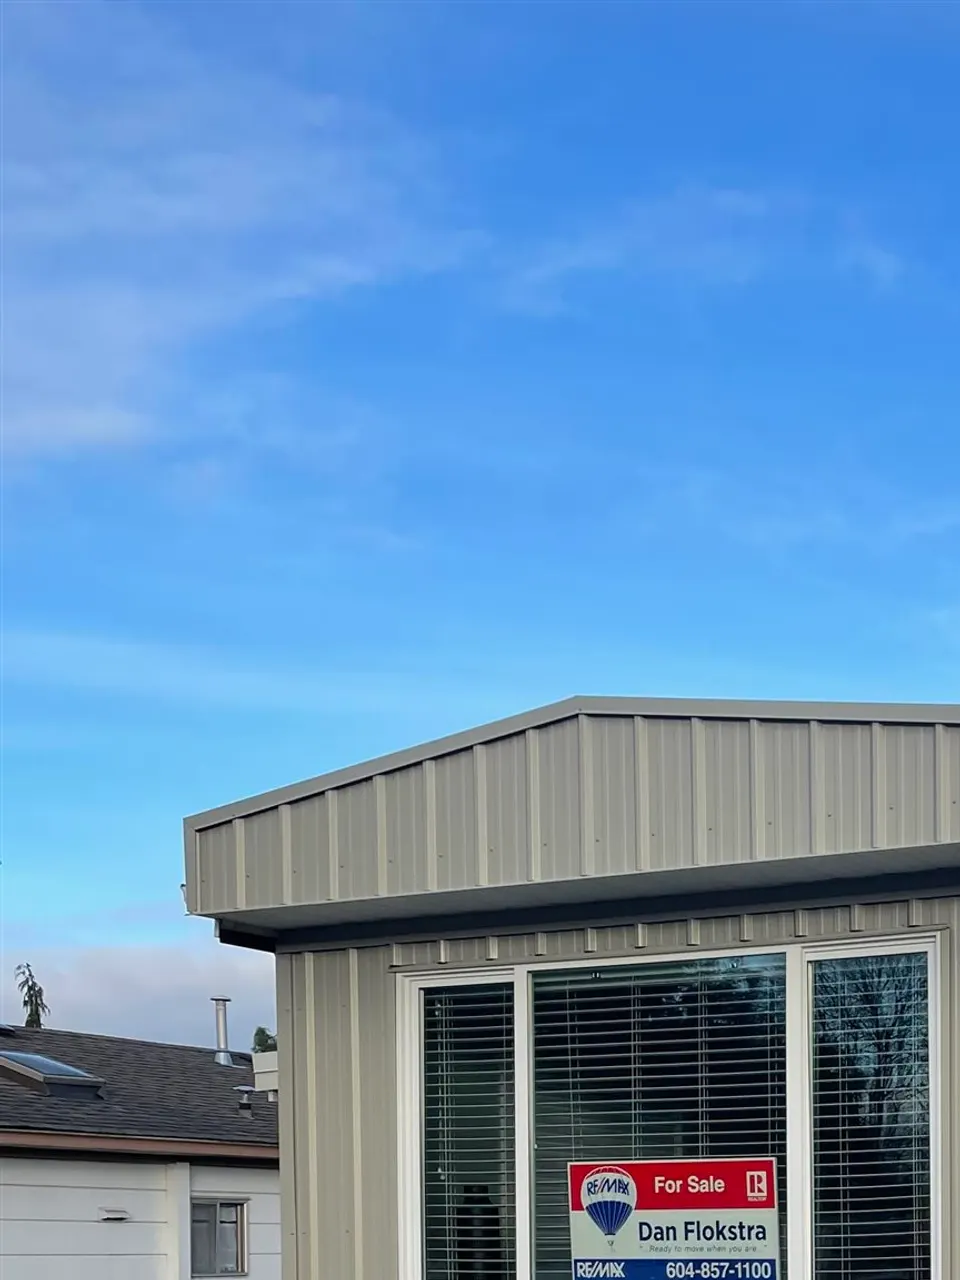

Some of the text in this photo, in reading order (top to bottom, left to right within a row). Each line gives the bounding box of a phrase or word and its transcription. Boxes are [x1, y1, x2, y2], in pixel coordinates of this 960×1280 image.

[586, 1177, 630, 1196] RE/MAX
[654, 1175, 725, 1194] For Sale
[638, 1220, 767, 1241] Dan Flokstra
[576, 1261, 625, 1278] RE/MAX
[666, 1262, 771, 1279] 604-857-1100
